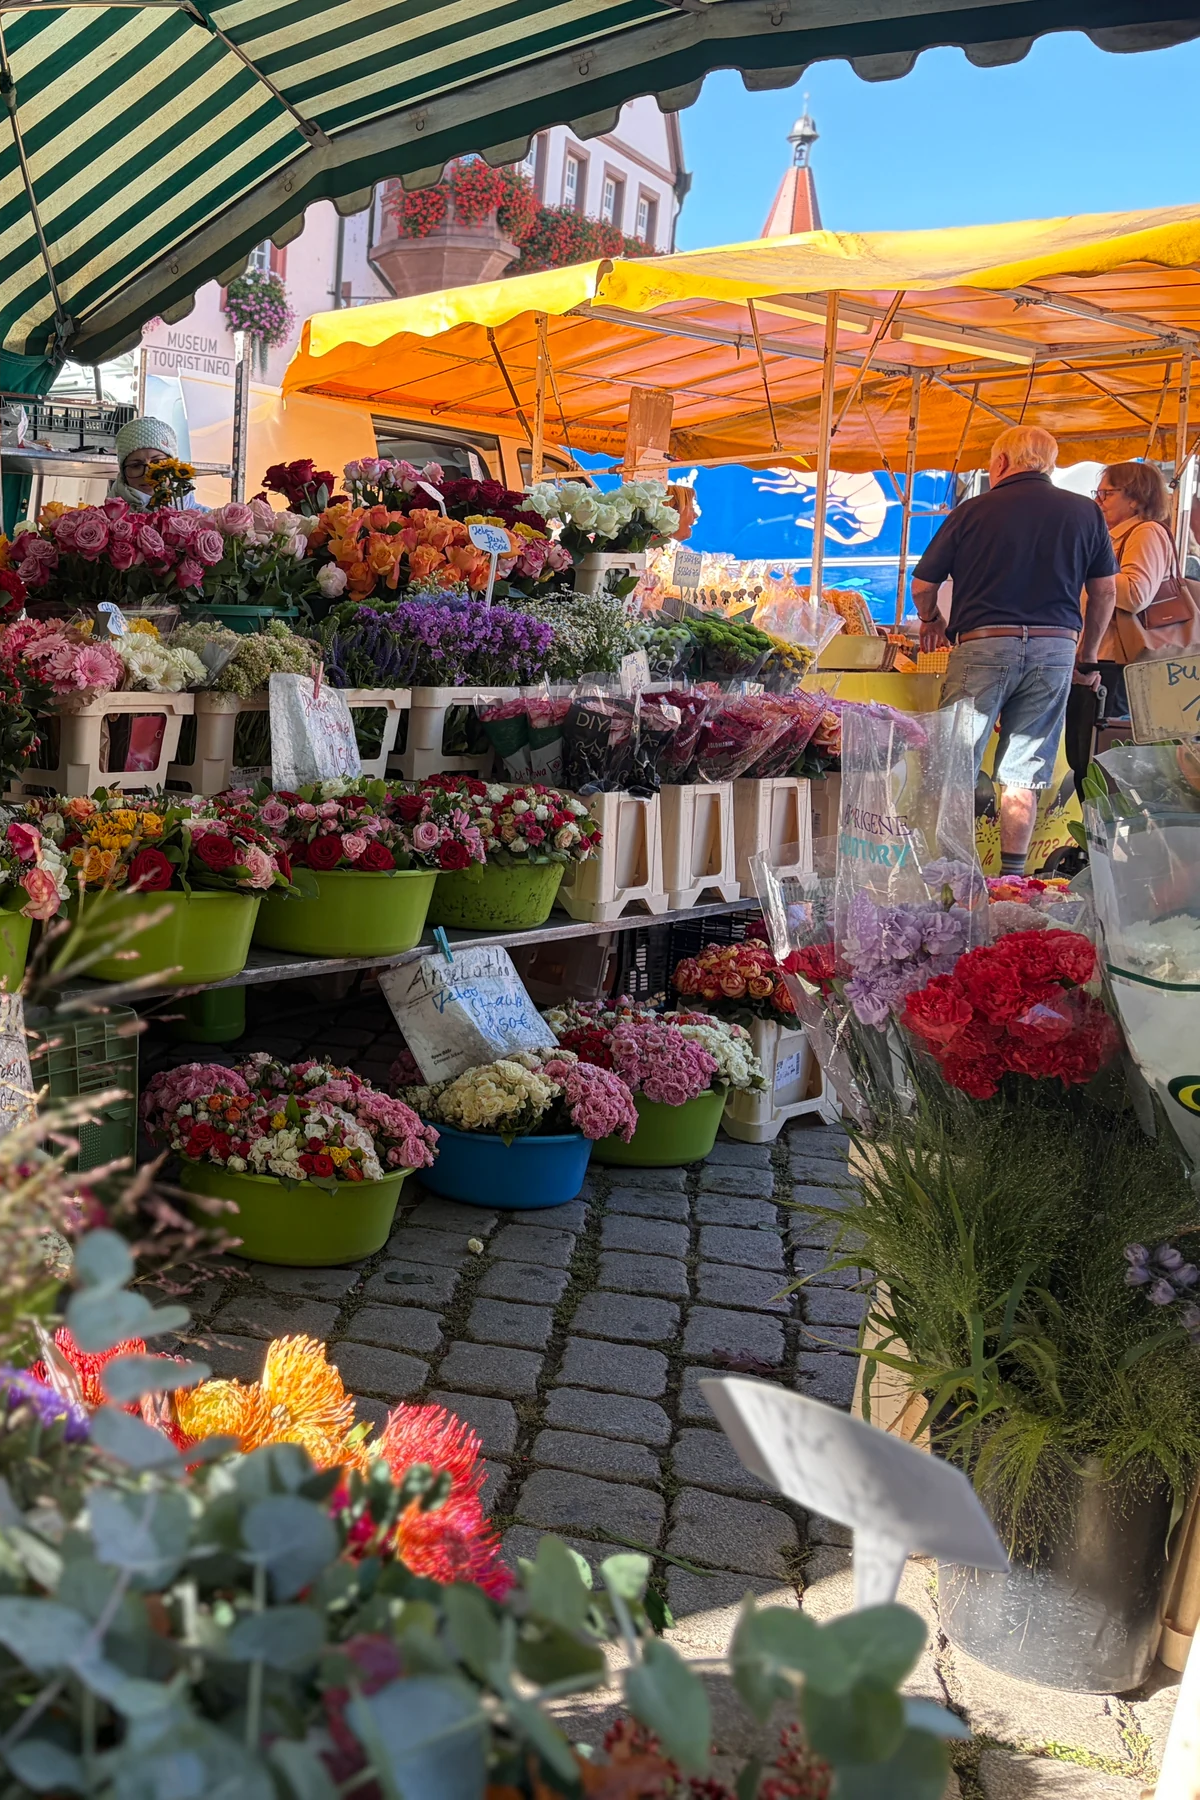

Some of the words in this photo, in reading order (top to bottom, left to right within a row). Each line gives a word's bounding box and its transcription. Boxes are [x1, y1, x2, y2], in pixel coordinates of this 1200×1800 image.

[167, 331, 218, 354] MUSEUM
[152, 350, 201, 371] TOURIST
[203, 358, 230, 377] INFO
[1166, 662, 1200, 686] Bu
